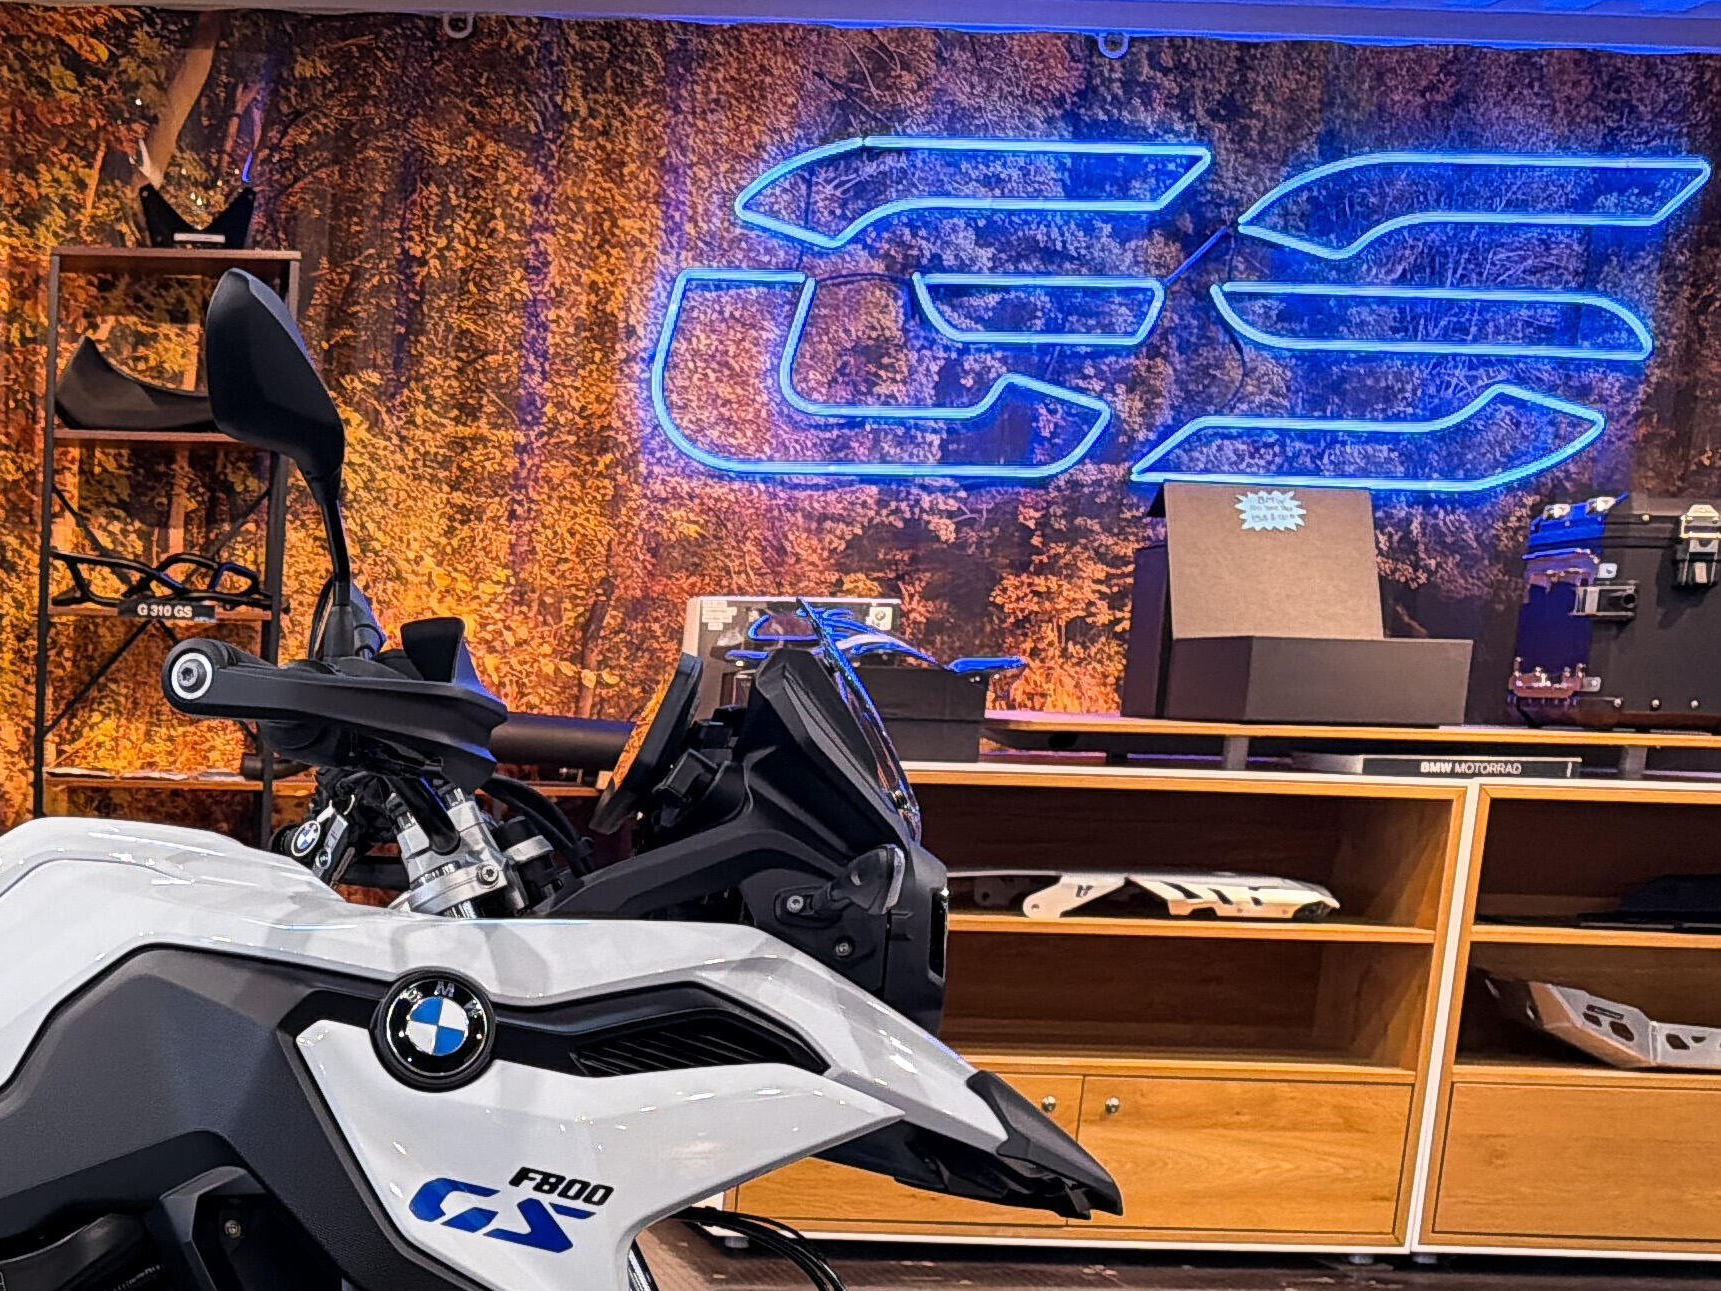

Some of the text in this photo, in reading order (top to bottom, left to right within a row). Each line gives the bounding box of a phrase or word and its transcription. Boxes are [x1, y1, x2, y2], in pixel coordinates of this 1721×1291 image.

[648, 136, 1715, 492] GS
[137, 603, 193, 618] G 310 GS
[1420, 761, 1522, 775] BMW MOTORRAD
[508, 1166, 615, 1207] F800
[408, 1176, 598, 1254] GS
